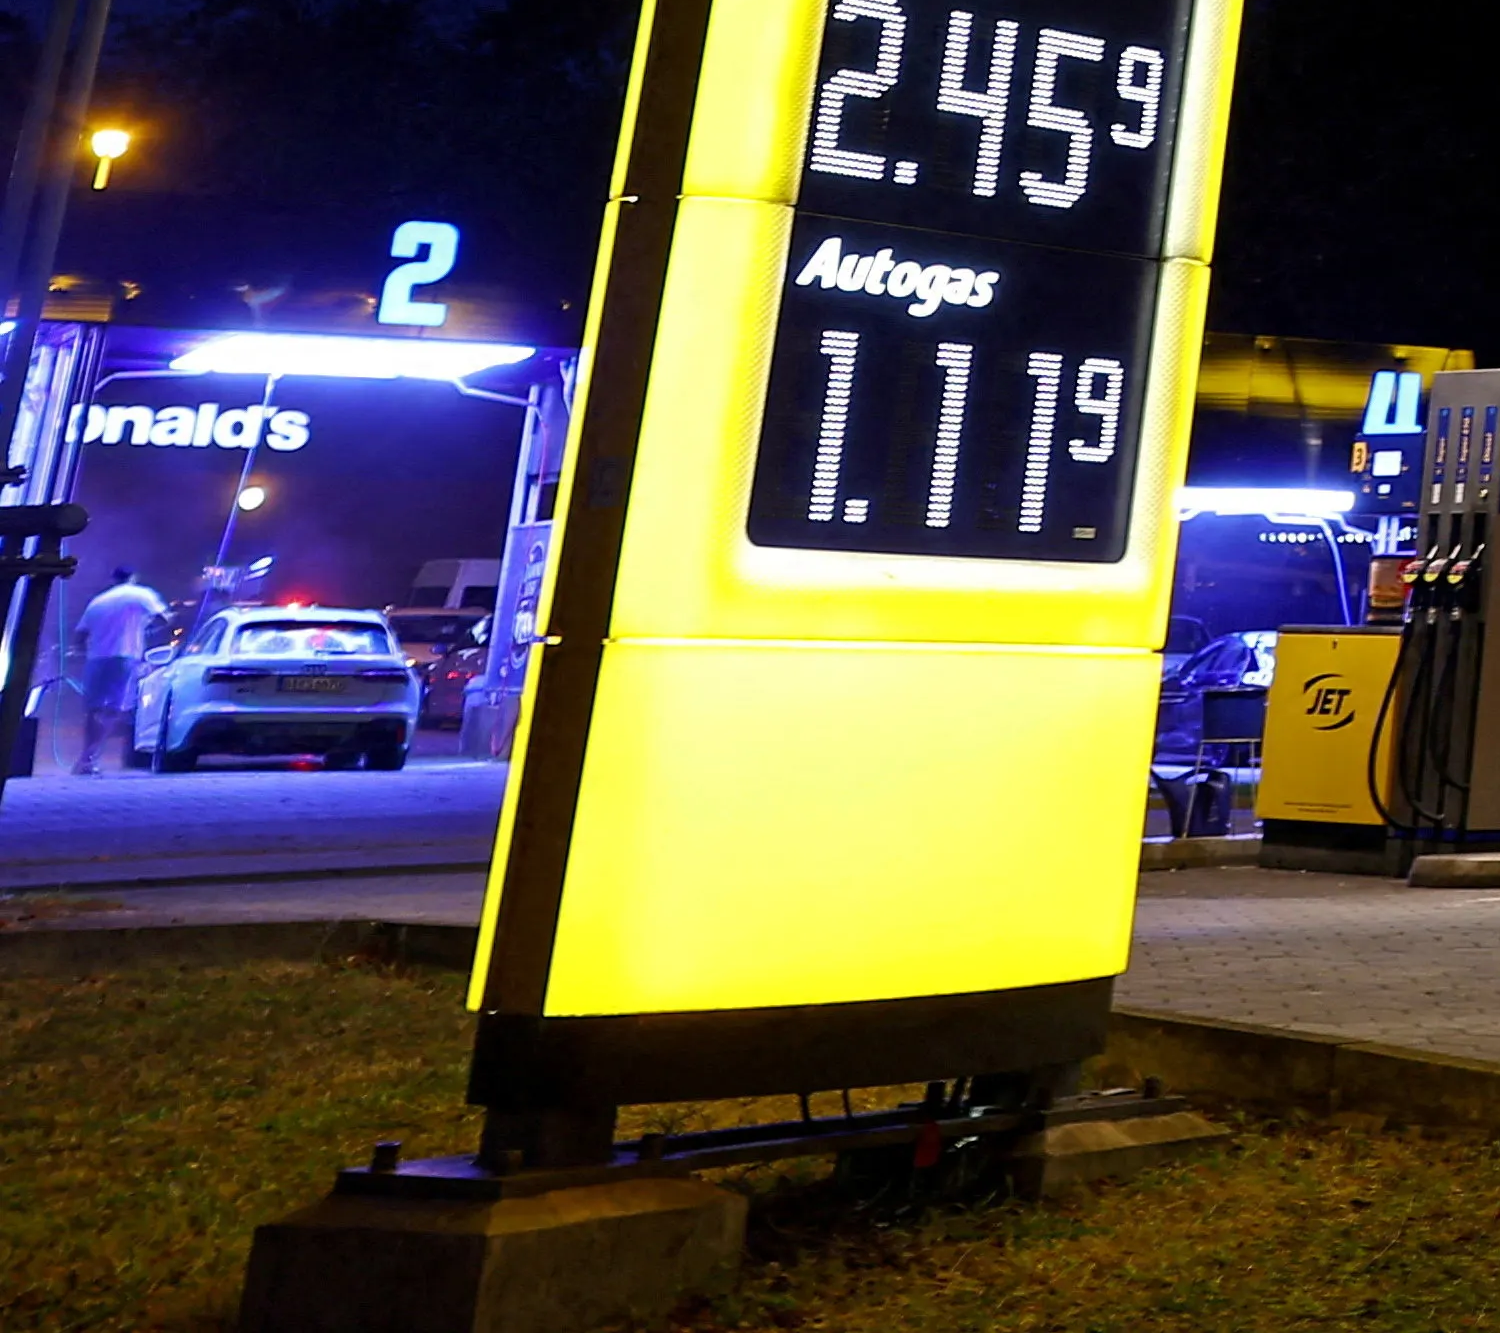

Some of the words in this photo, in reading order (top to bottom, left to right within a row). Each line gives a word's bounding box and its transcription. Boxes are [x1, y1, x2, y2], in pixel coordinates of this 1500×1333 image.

[377, 220, 460, 327] 2
[795, 237, 1000, 317] Autogas
[1355, 447, 1364, 469] 3
[1305, 688, 1352, 715] JET
